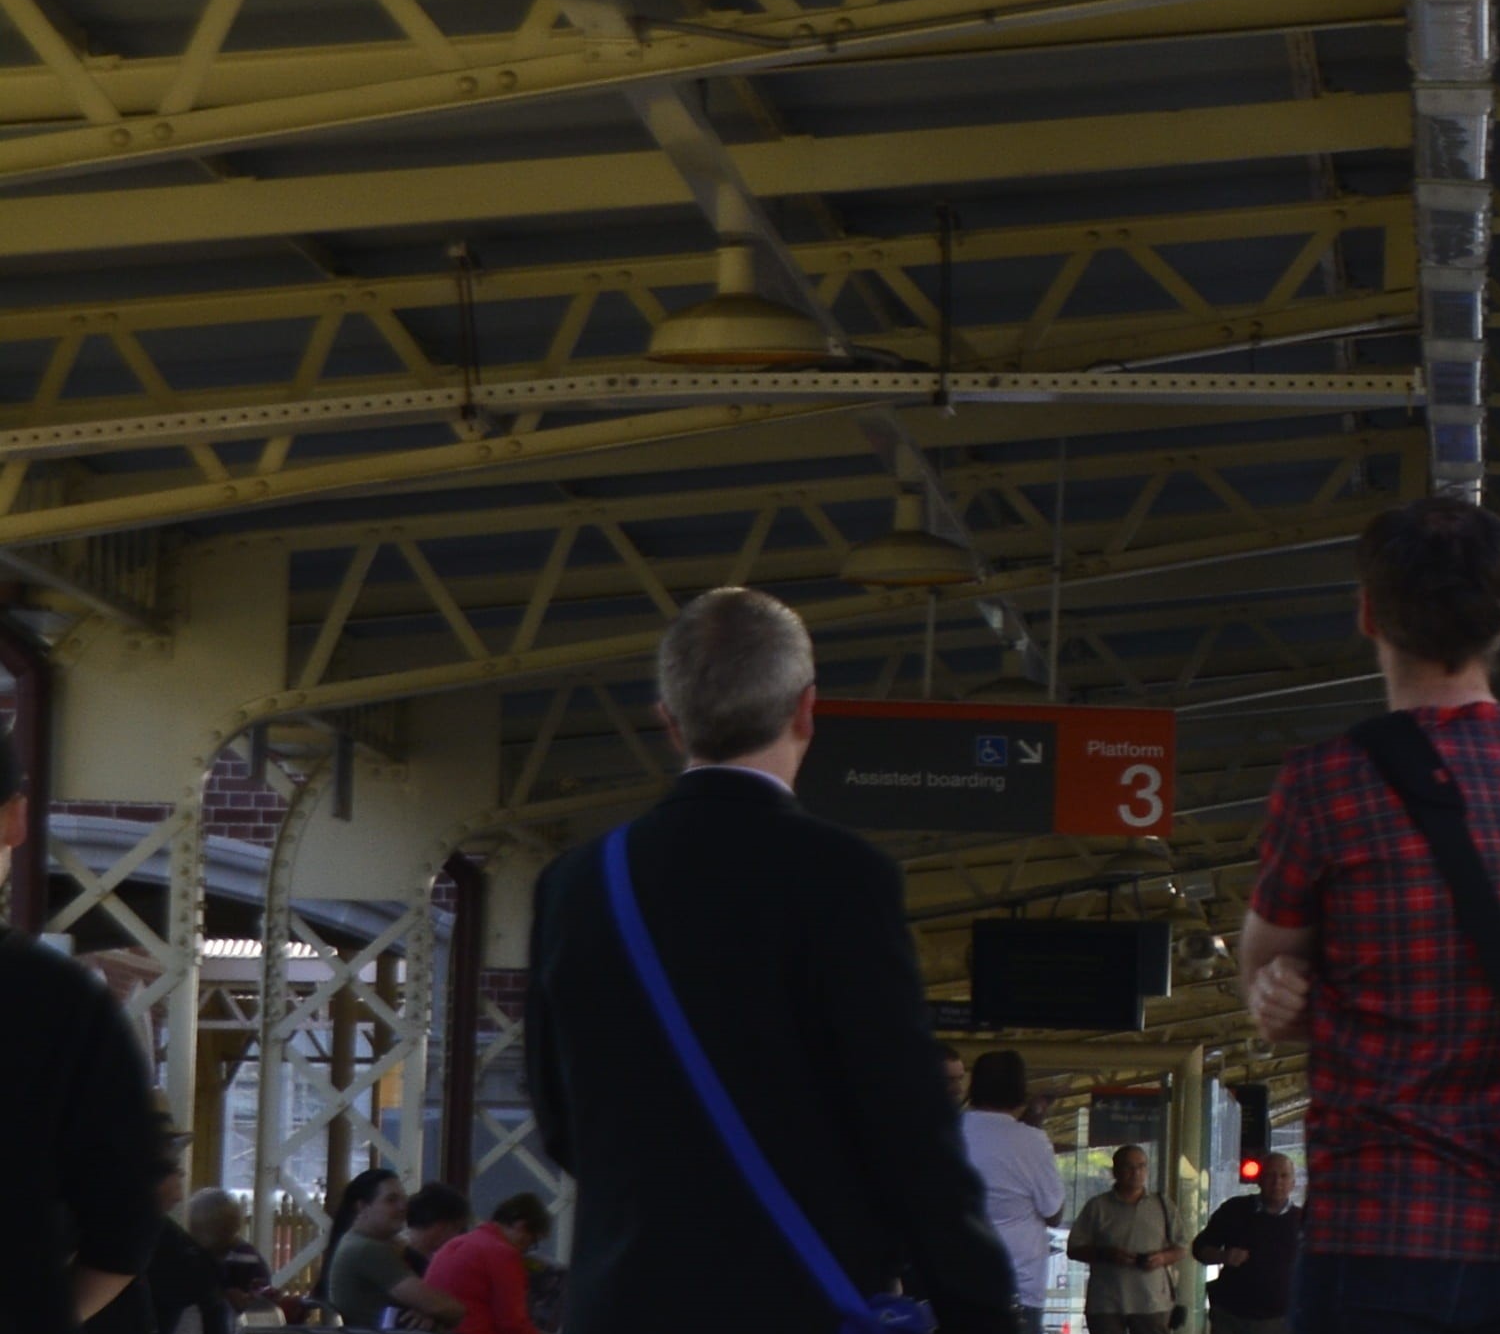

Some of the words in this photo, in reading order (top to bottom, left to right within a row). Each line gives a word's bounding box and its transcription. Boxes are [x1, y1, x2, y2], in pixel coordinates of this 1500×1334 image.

[1086, 739, 1164, 759] Platform
[845, 768, 923, 787] Assisted
[926, 770, 1006, 792] boarding
[1117, 763, 1164, 828] 3
